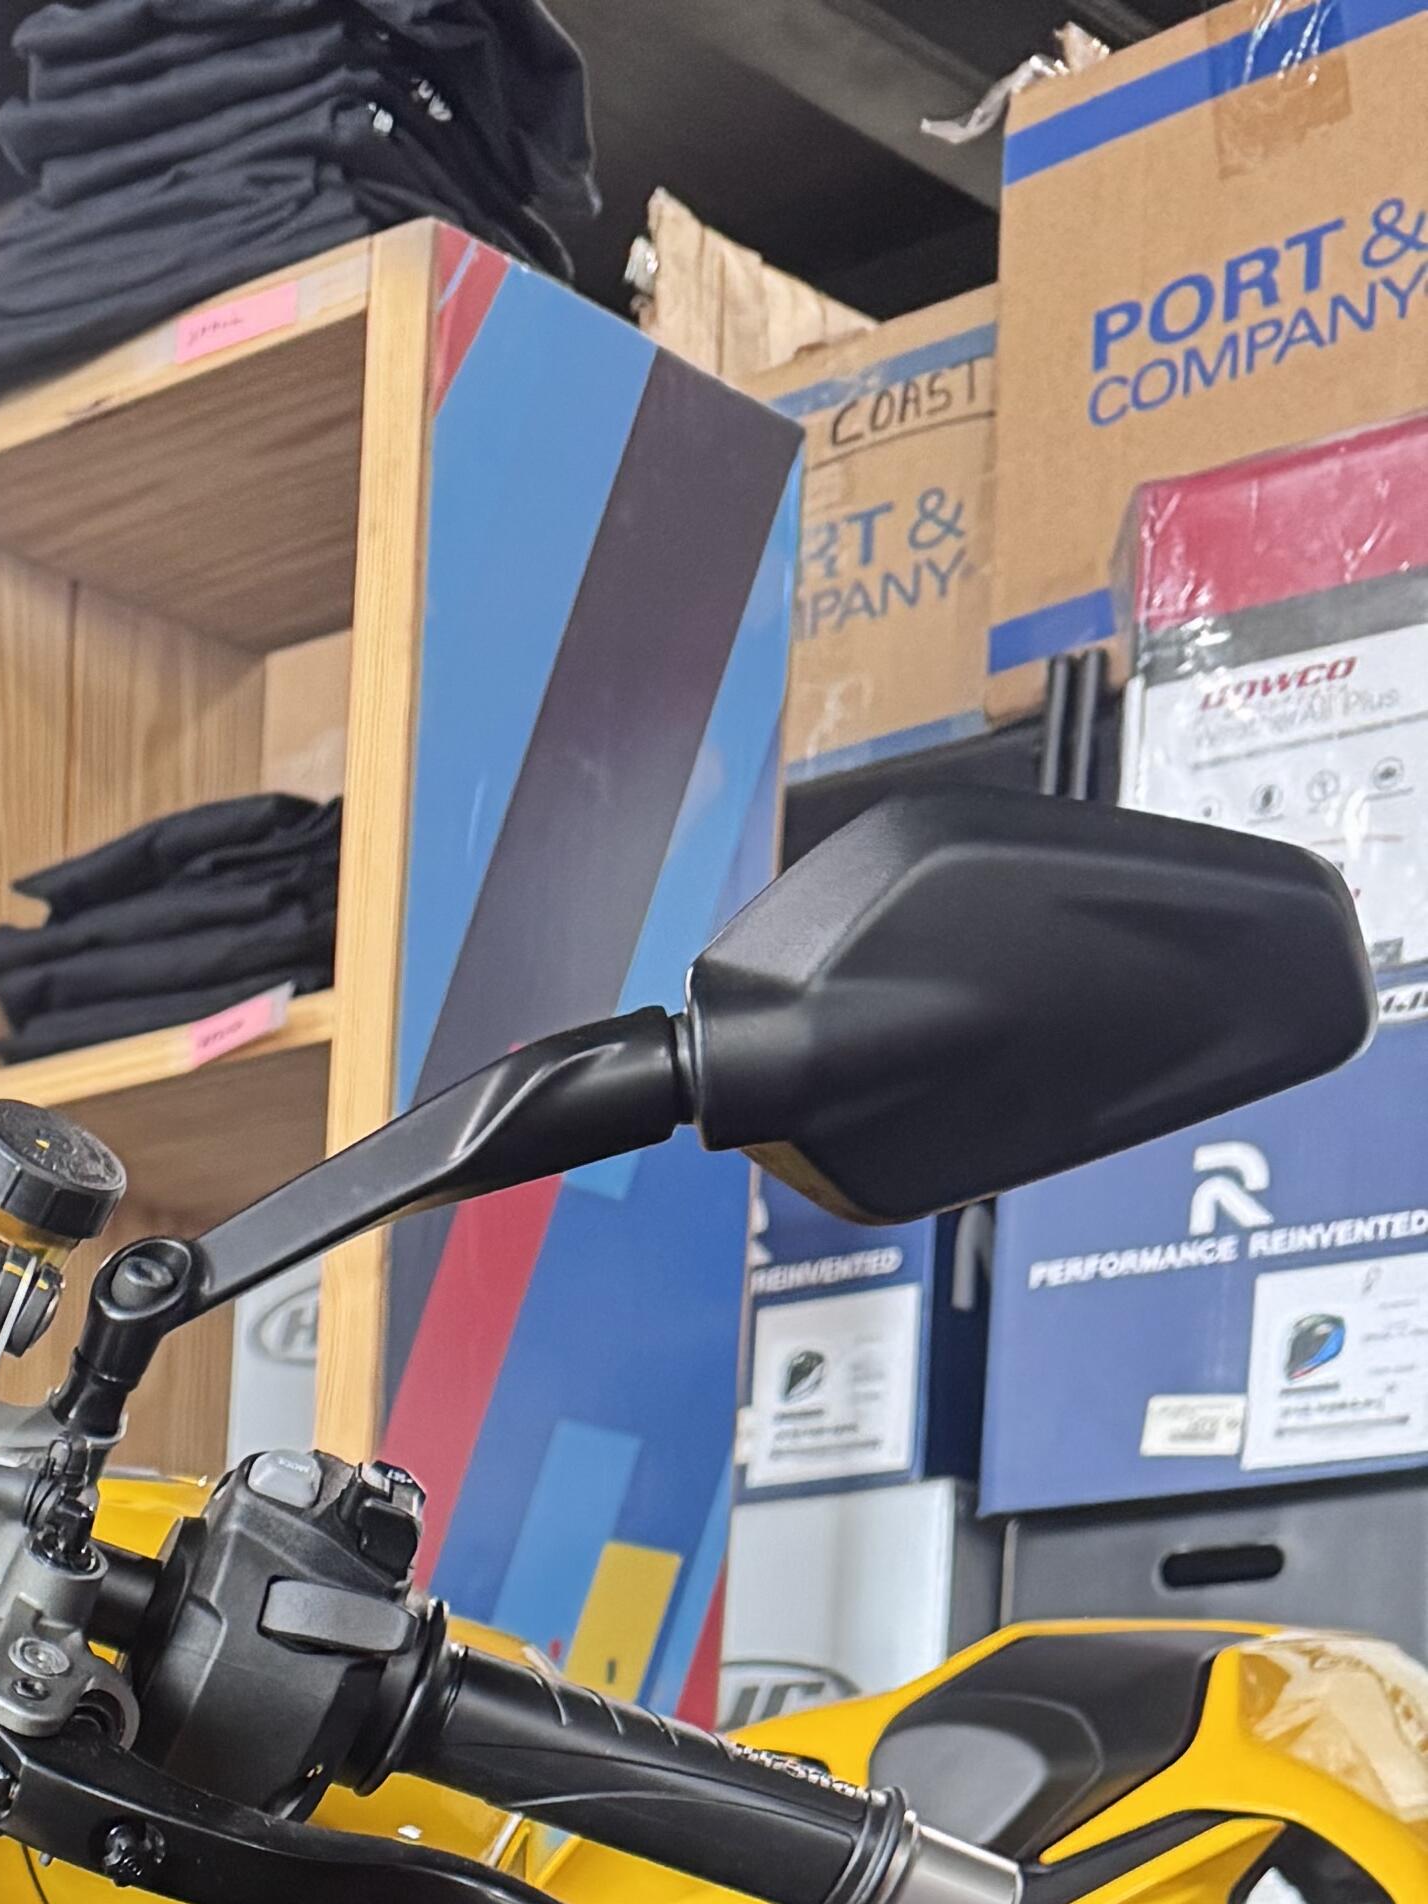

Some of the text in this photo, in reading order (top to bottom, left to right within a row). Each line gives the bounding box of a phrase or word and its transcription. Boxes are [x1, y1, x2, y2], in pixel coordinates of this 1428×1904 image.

[1092, 197, 1428, 374] PORT &
[1088, 260, 1428, 427] COMPANY
[831, 355, 994, 447] COAST
[909, 487, 967, 551] &
[1028, 1208, 1428, 1290] PERFORMANCE REINVENTED
